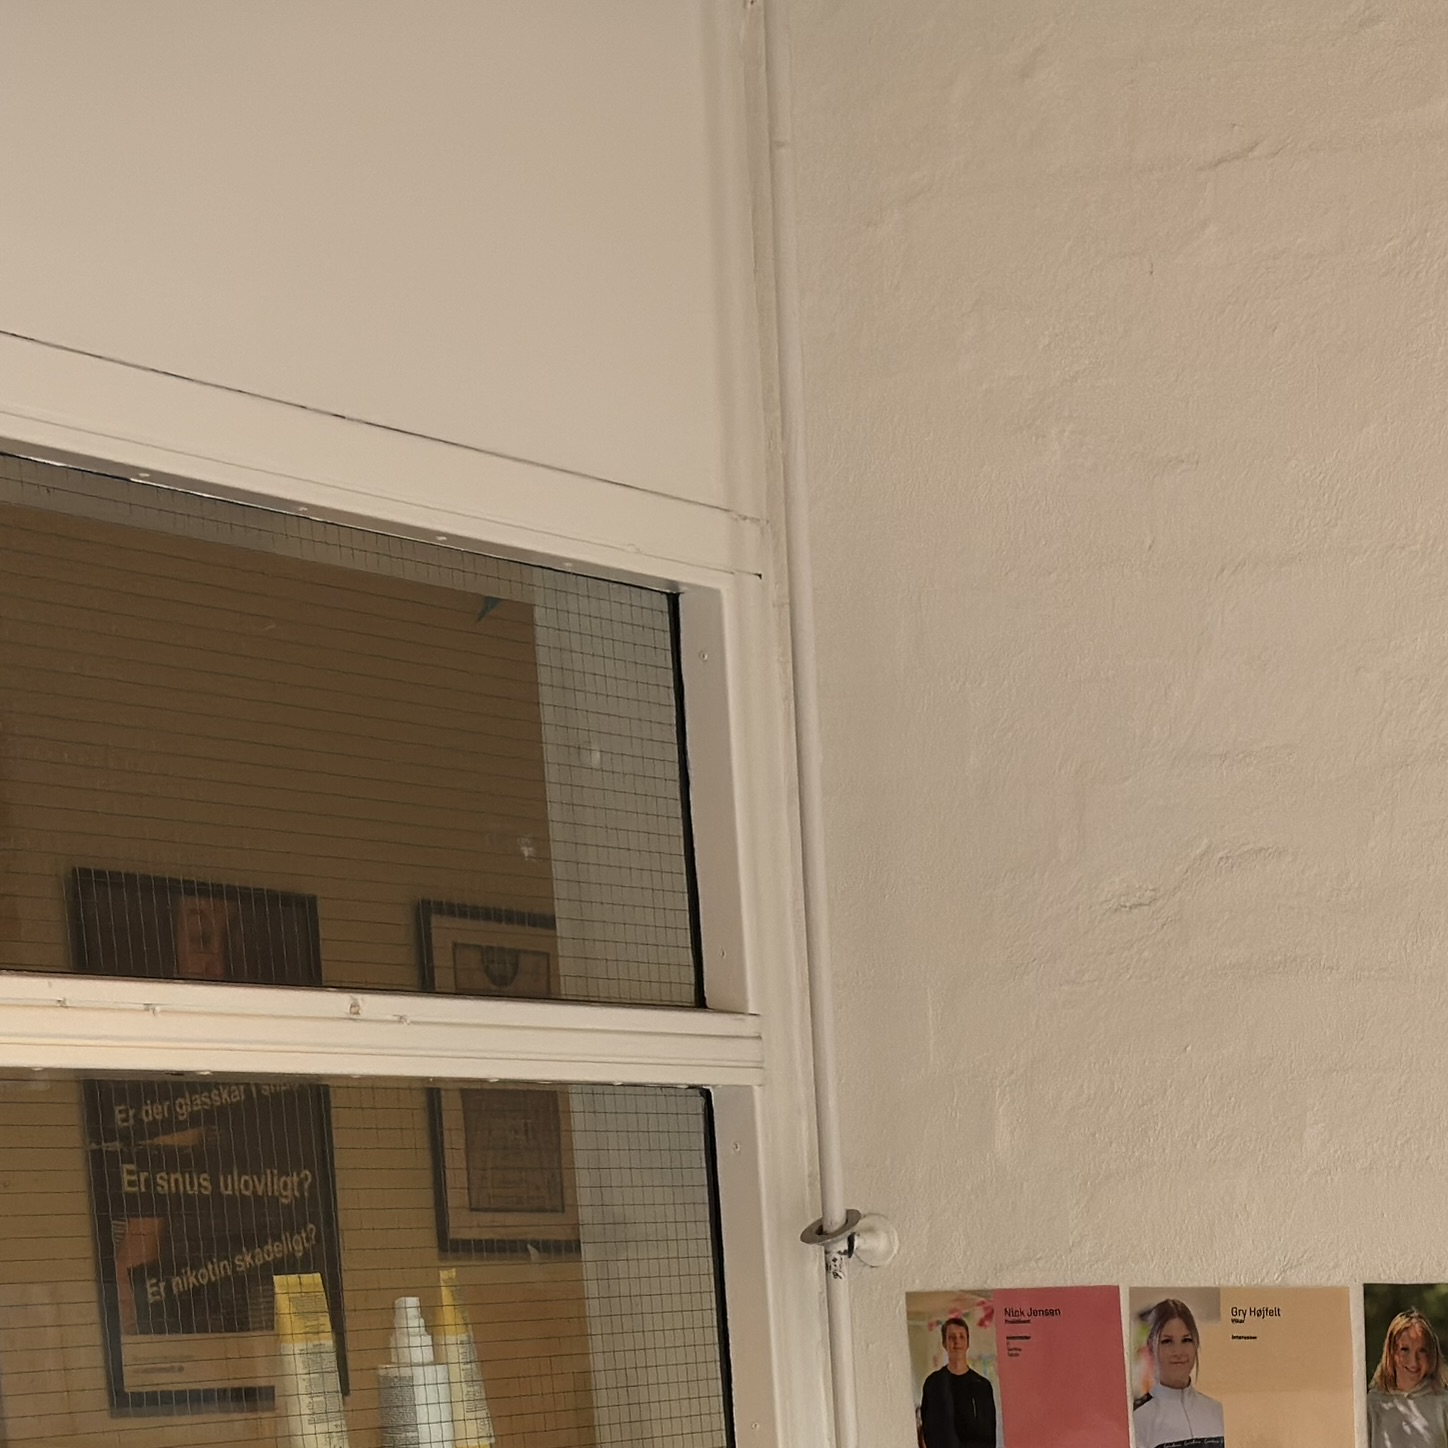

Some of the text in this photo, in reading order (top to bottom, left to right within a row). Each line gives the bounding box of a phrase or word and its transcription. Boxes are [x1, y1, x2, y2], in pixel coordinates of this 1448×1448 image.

[121, 1163, 312, 1203] Er snus ulovligt?
[146, 1223, 317, 1303] Er nikotin skadeligt?
[1004, 1307, 1061, 1316] Nick Jensen
[1231, 1307, 1280, 1319] Gry Højfelt
